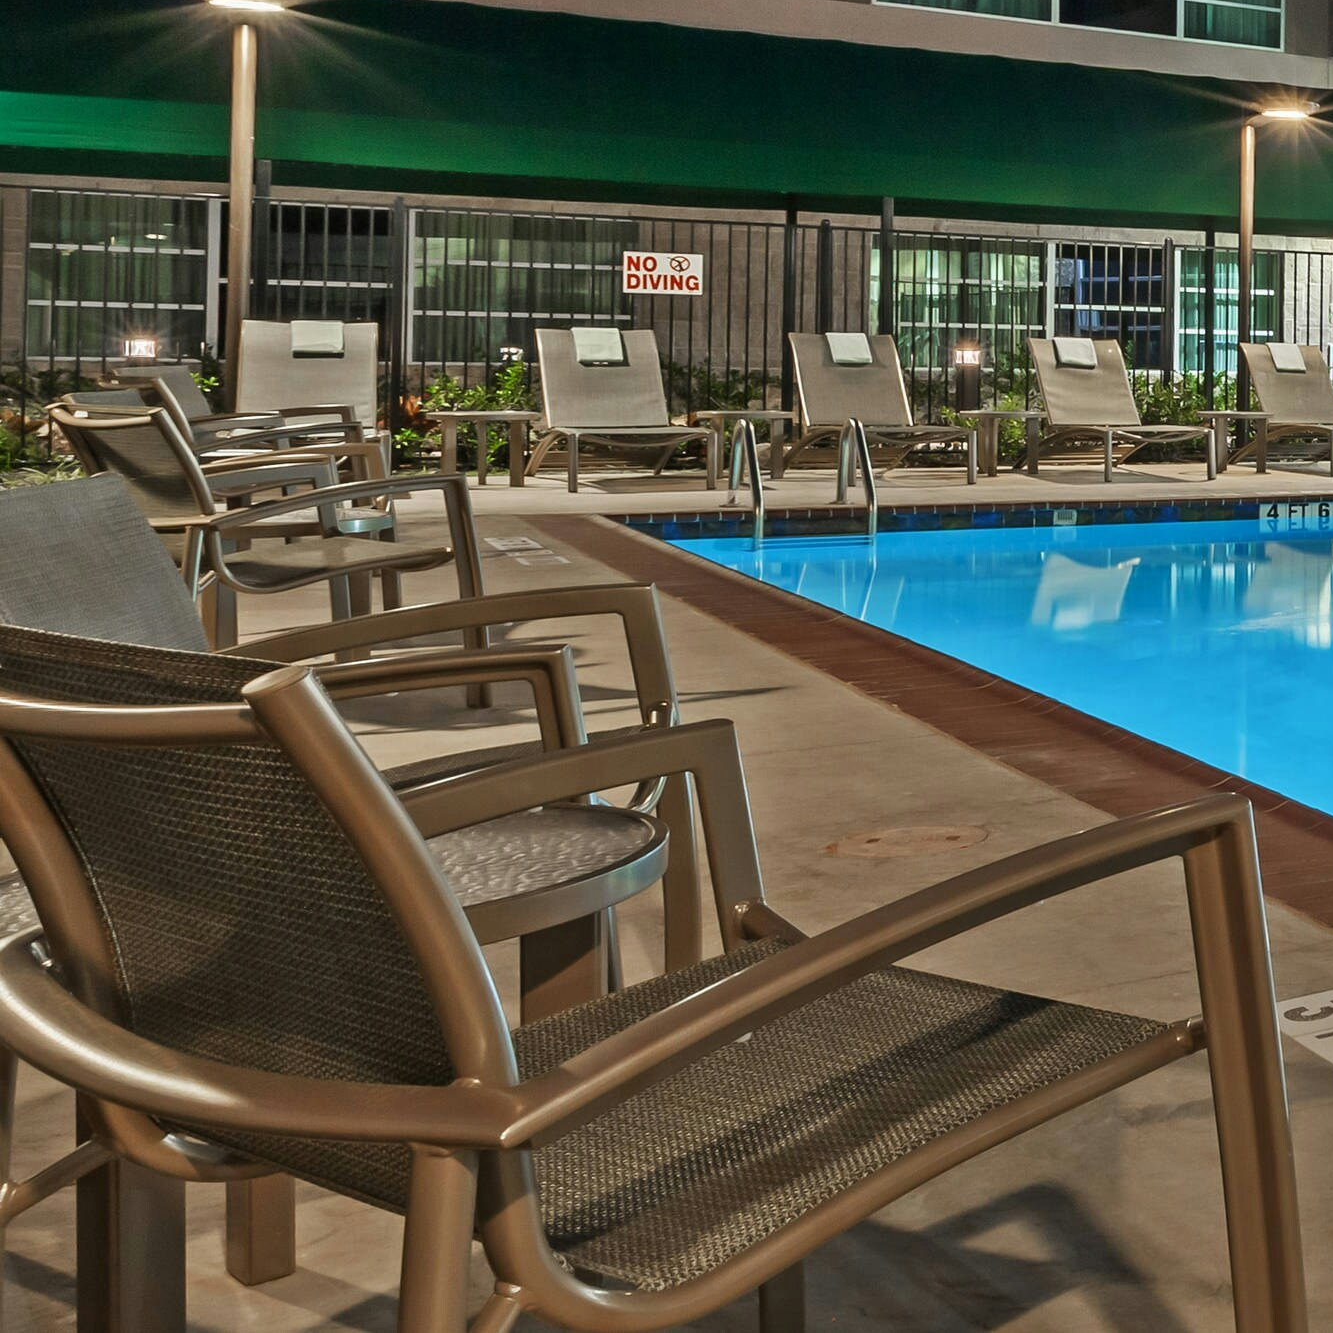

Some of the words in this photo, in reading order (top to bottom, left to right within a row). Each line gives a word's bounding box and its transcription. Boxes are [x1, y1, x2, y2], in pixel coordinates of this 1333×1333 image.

[626, 256, 657, 272] NO
[626, 274, 700, 291] DIVING
[1266, 503, 1279, 519] 4
[1288, 504, 1309, 518] FT
[1318, 502, 1330, 517] 6
